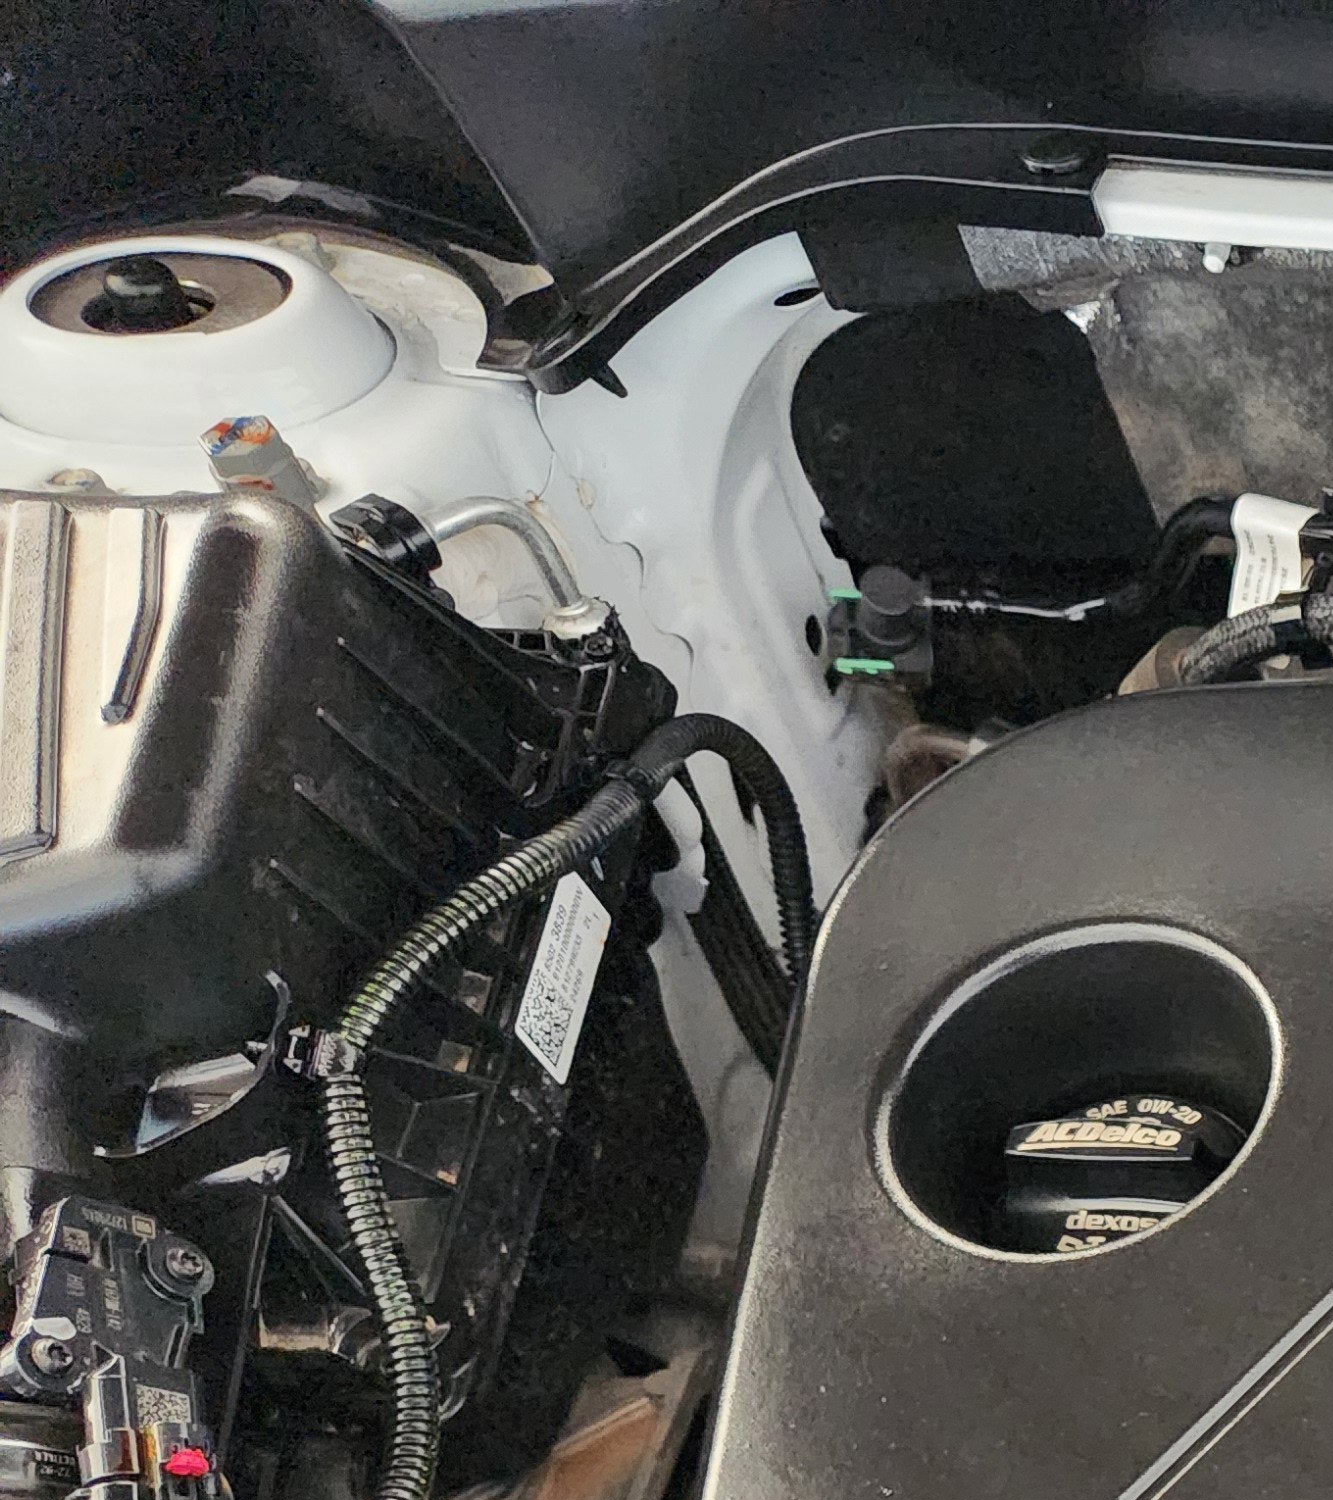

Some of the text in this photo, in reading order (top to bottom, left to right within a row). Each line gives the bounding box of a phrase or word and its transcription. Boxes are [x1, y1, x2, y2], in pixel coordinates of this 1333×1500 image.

[1086, 1098, 1202, 1125] SAE 0W-20
[1025, 1121, 1182, 1147] ACDelco
